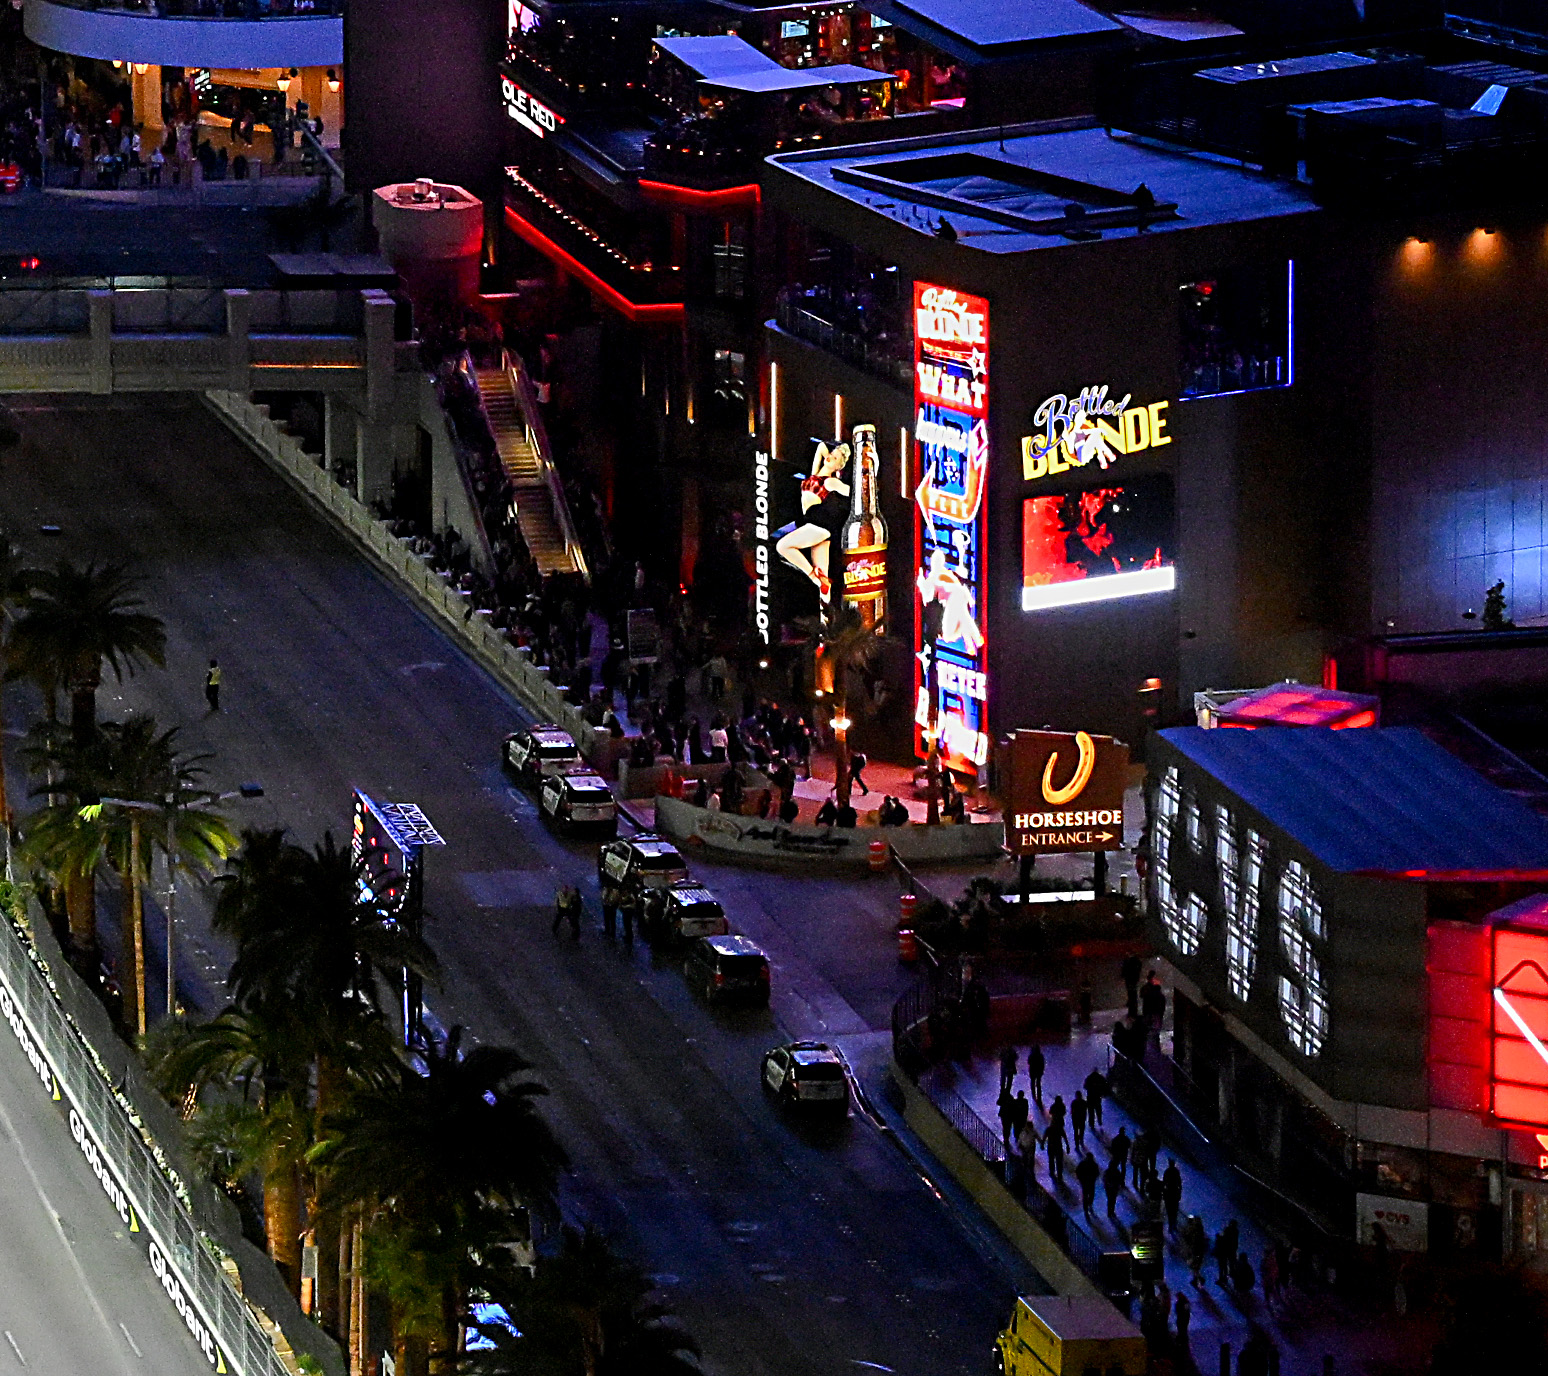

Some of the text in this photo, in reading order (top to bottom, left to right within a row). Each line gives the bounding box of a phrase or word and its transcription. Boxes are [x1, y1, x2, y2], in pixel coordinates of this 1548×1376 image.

[502, 78, 527, 113] OLE
[530, 96, 556, 133] RED
[917, 361, 987, 409] WHAT
[1027, 384, 1133, 460] Bottled
[756, 450, 770, 544] BLONDE
[1014, 809, 1123, 829] HORSESHOE
[1021, 830, 1094, 846] ENTRANCE
[1156, 764, 1332, 1059] CVS
[69, 1108, 130, 1224] Globant
[148, 1241, 216, 1365] Globant
